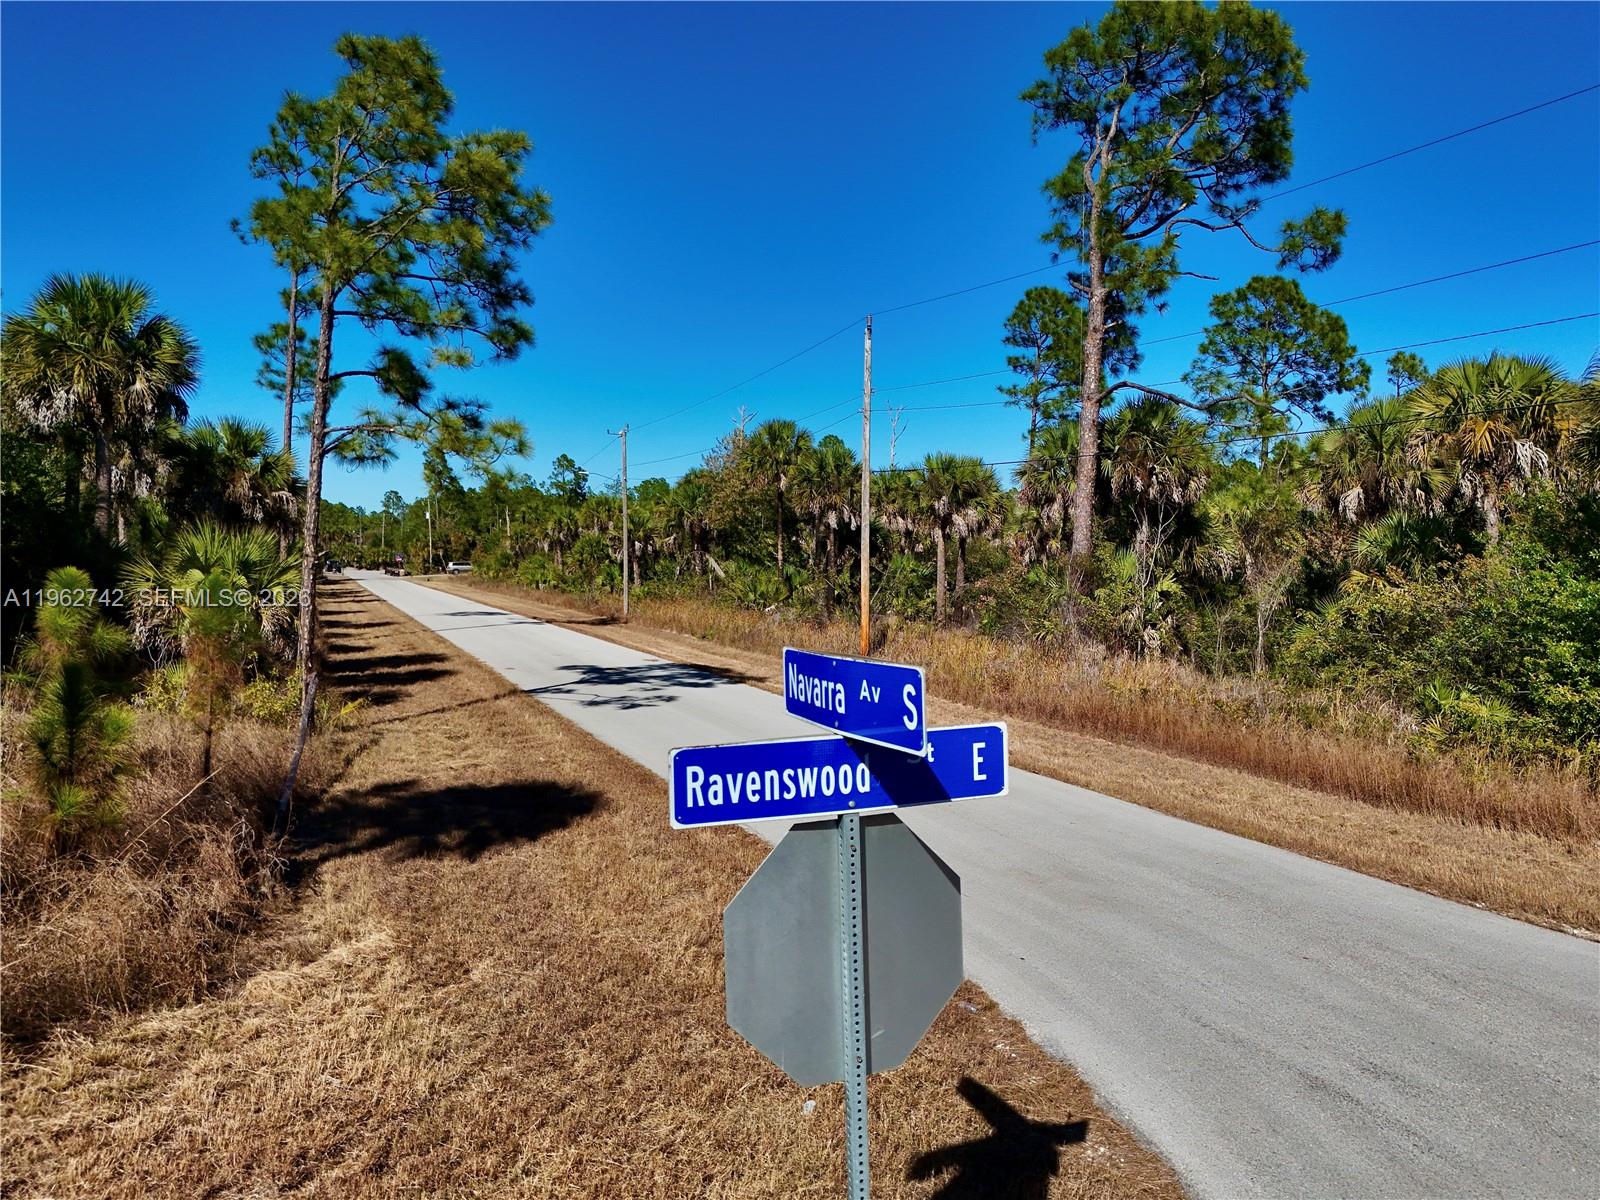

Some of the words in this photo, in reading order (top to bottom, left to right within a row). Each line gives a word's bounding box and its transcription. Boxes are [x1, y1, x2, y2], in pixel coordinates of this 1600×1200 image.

[788, 663, 845, 715] Navarra
[860, 679, 881, 703] Av
[902, 684, 918, 730] S
[685, 754, 870, 808] Ravenswood
[972, 743, 987, 781] E
